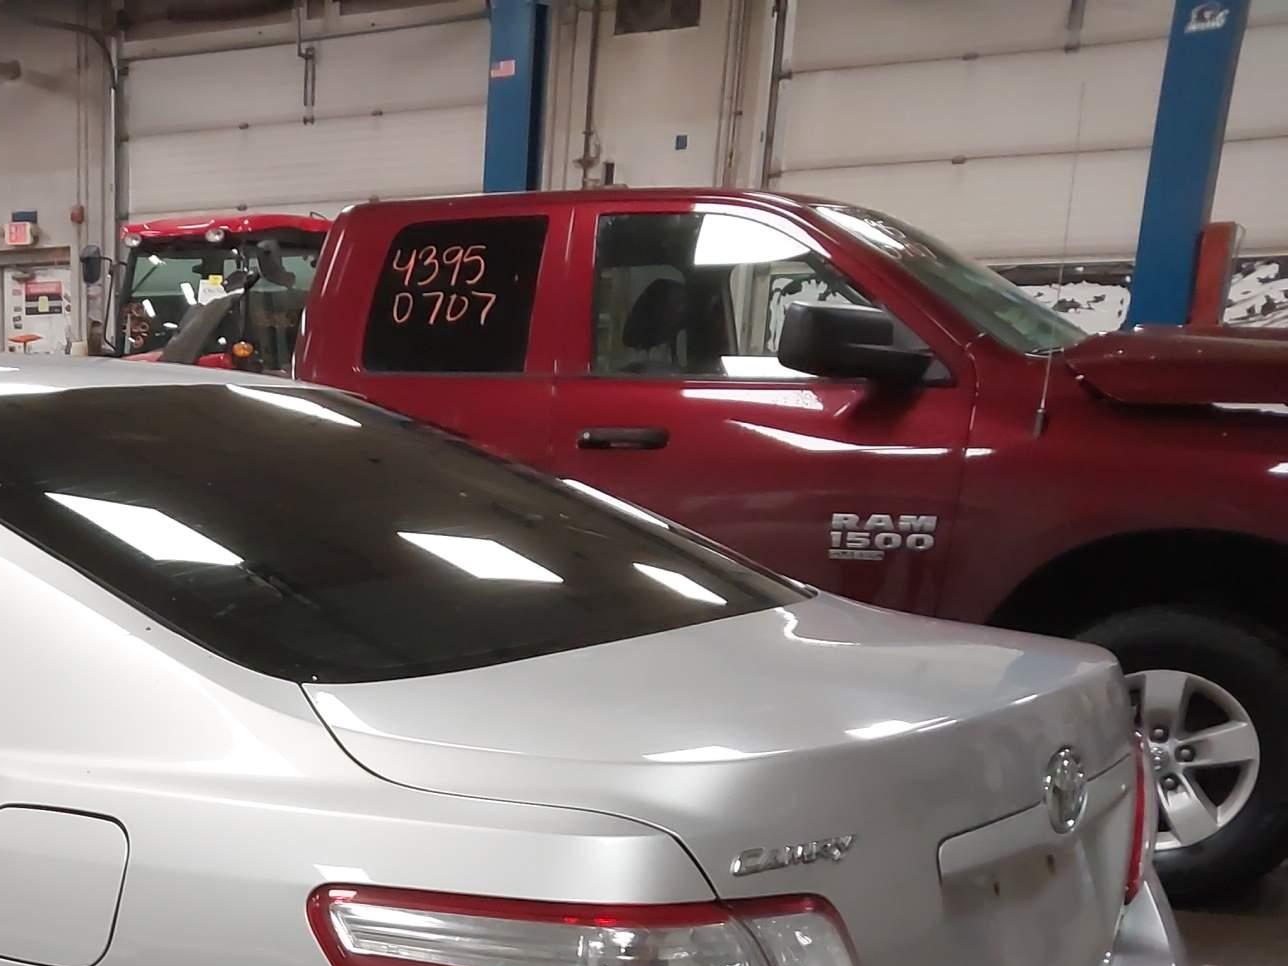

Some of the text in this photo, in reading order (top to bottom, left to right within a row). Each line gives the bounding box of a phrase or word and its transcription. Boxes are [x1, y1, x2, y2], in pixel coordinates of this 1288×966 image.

[392, 245, 487, 287] 4395
[392, 290, 497, 326] 0707
[831, 512, 938, 532] RAM
[829, 531, 935, 551] 1500
[729, 833, 855, 876] CAMRY
